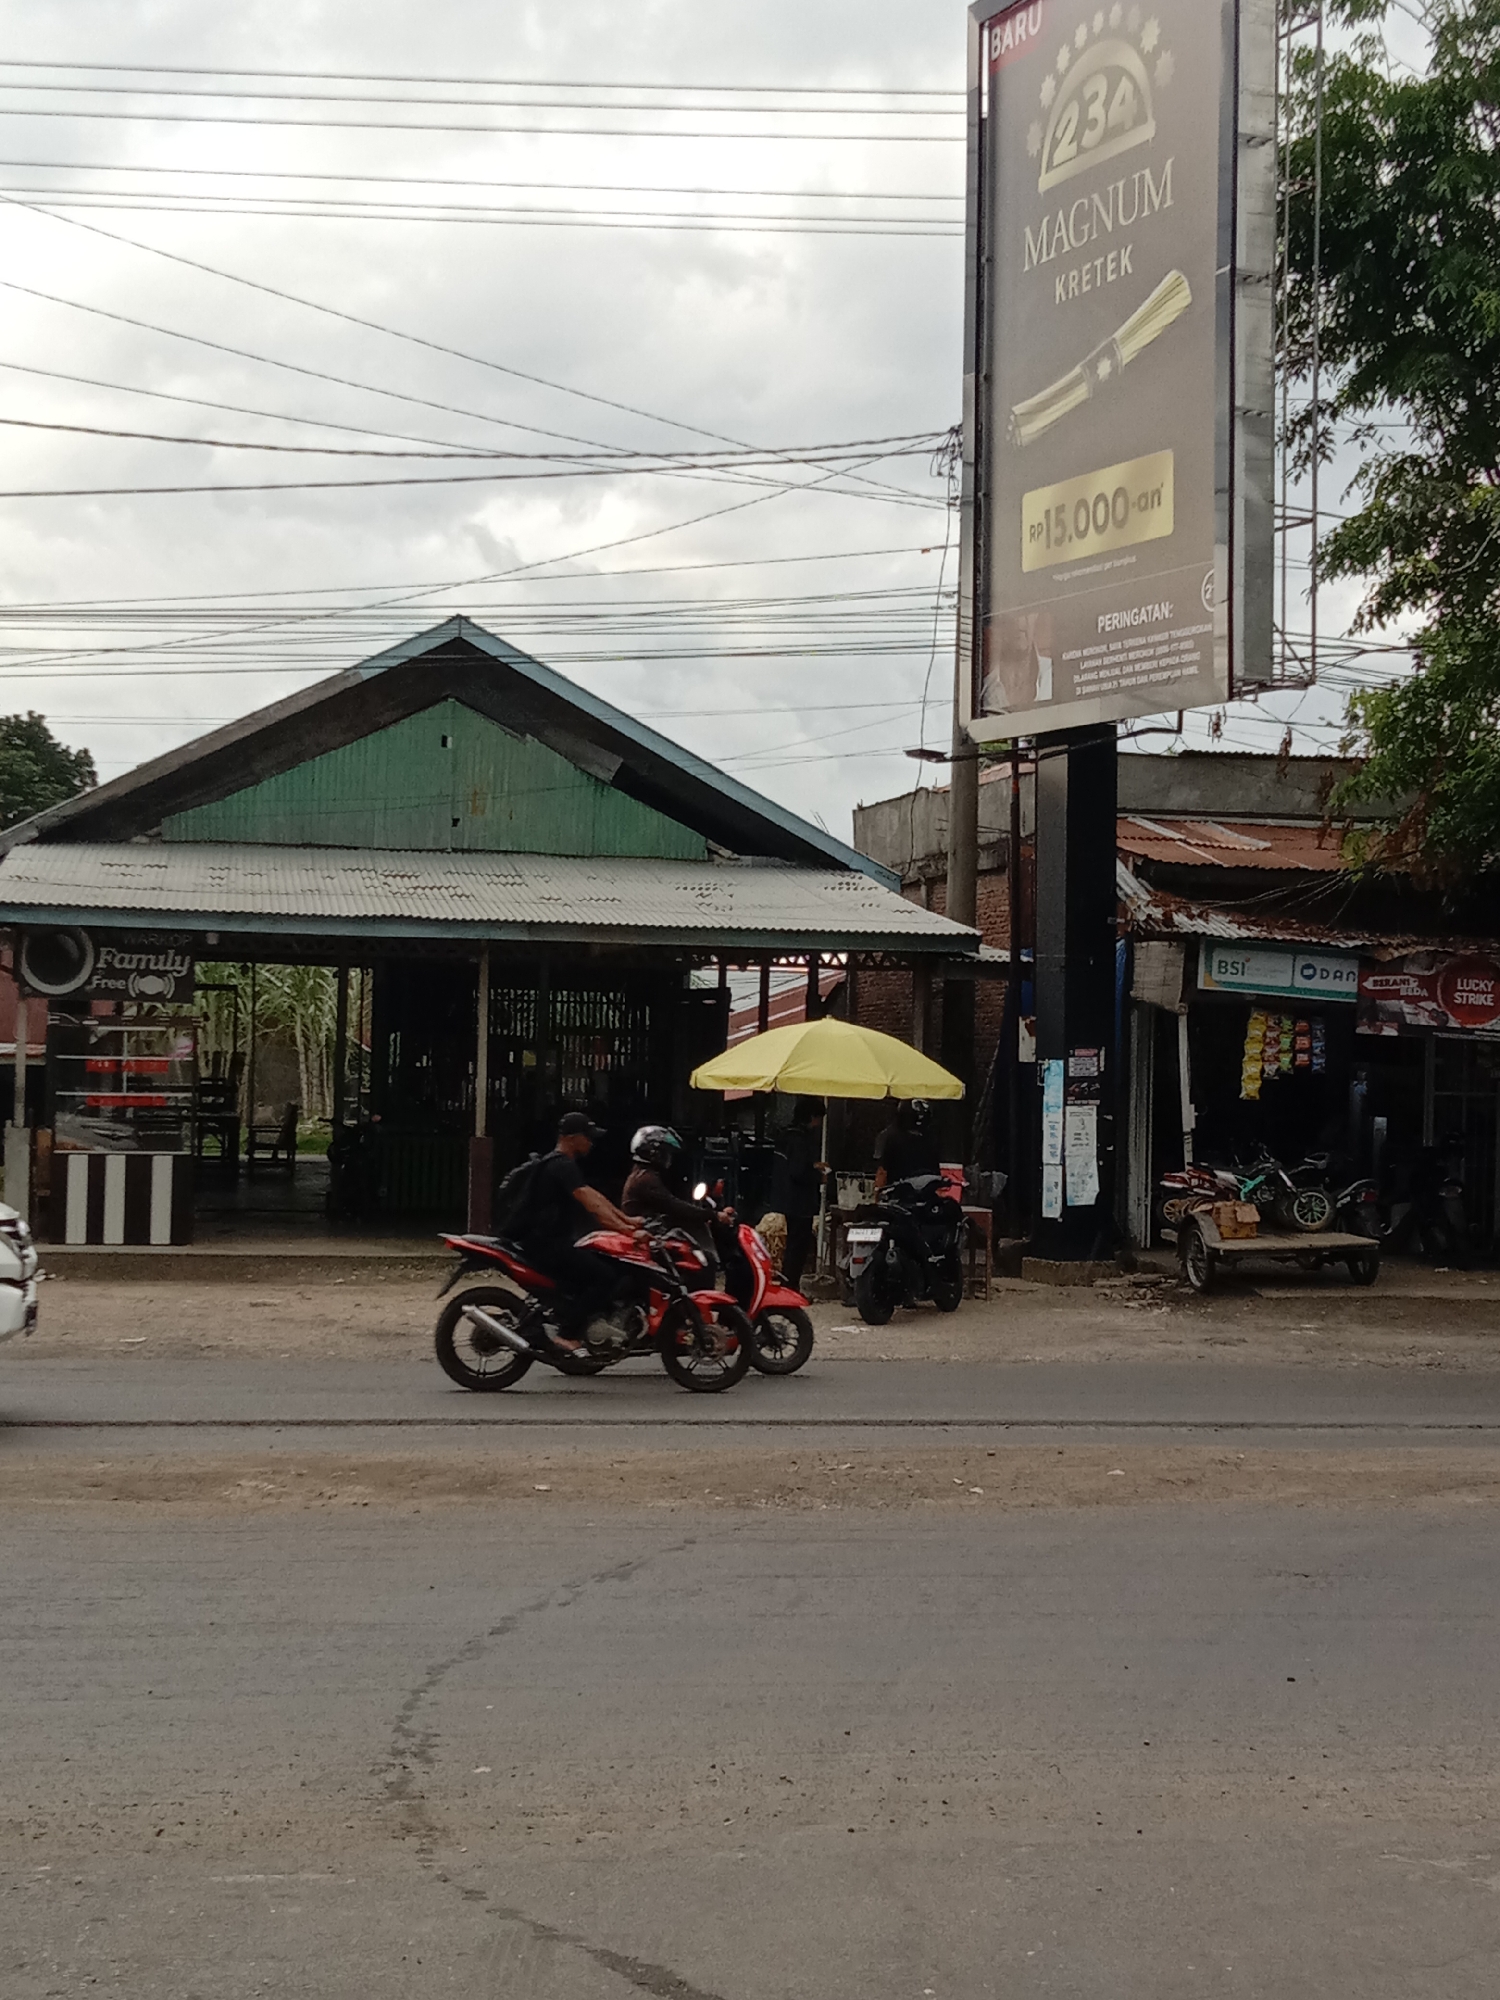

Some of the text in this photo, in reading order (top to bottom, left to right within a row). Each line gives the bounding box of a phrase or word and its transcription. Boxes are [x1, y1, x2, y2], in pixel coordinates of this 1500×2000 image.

[991, 0, 1042, 61] BARU
[1053, 74, 1138, 167] 234
[1023, 156, 1175, 272] MAGNUM
[1055, 245, 1133, 304] KRETEK
[1097, 601, 1174, 633] PERINGATAN:
[95, 947, 191, 977] Family
[1217, 959, 1246, 977] BSI
[92, 975, 126, 989] Free
[1457, 977, 1495, 992] LUCKY
[1453, 991, 1495, 1007] STRIKE
